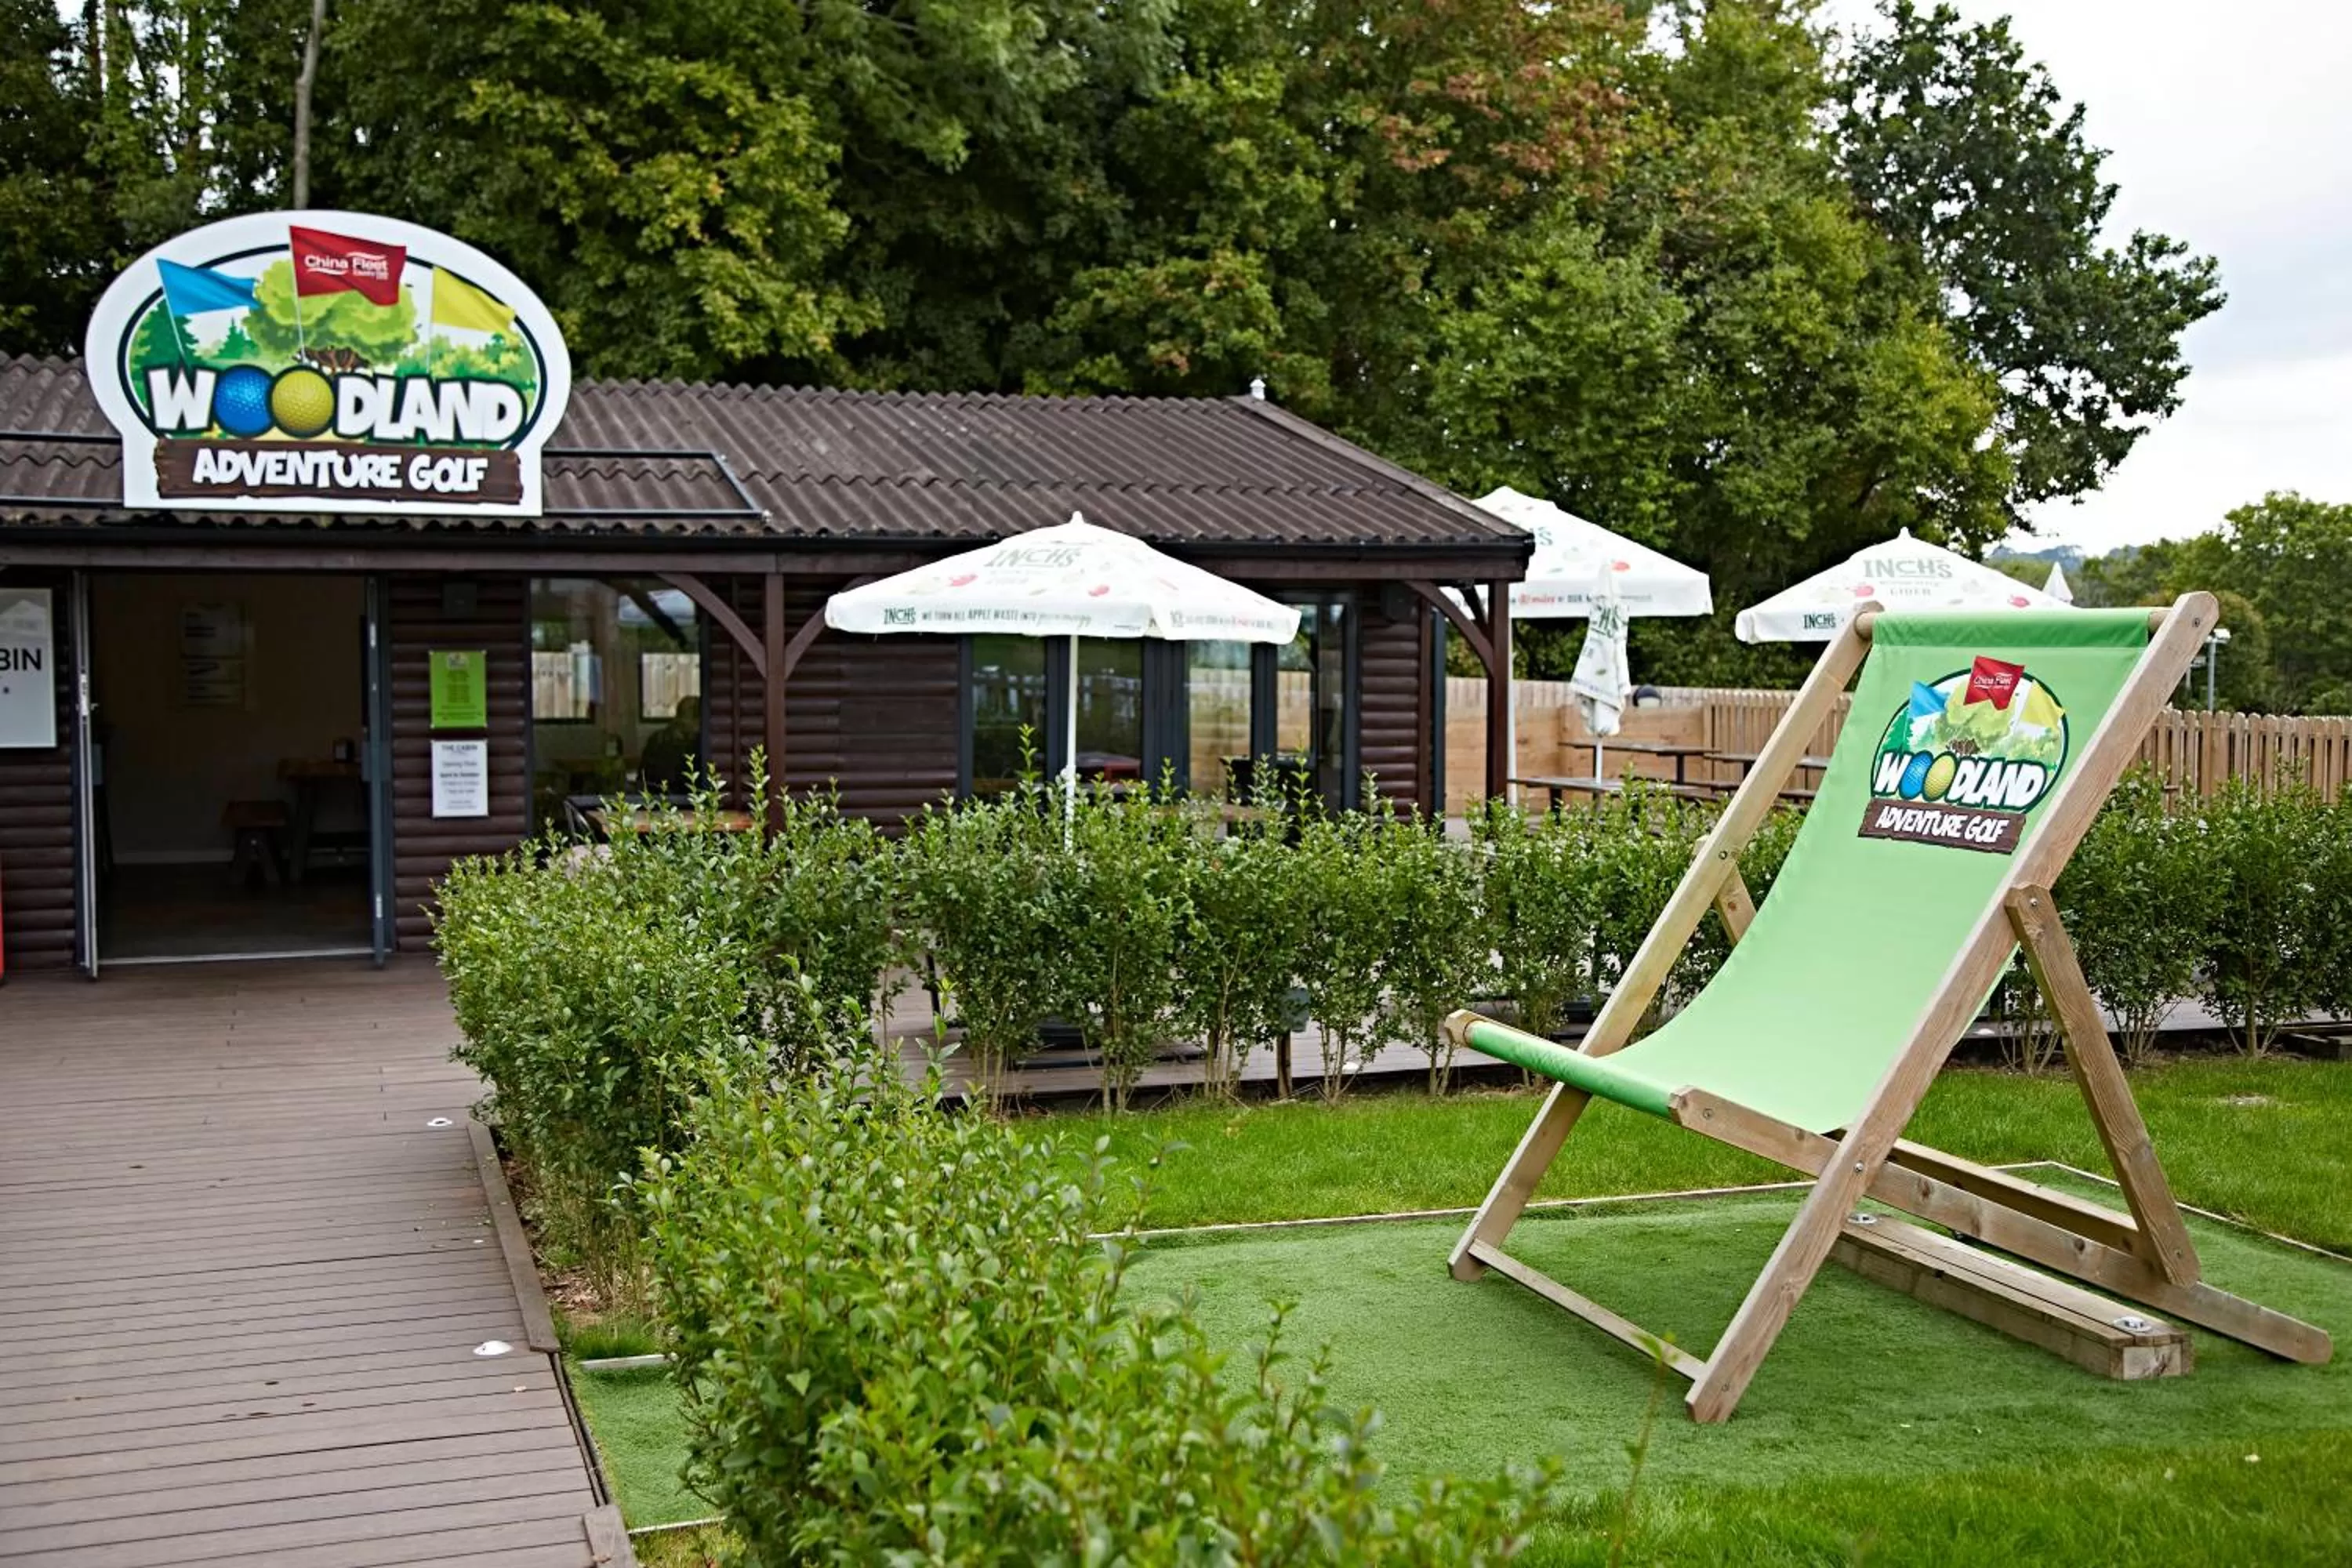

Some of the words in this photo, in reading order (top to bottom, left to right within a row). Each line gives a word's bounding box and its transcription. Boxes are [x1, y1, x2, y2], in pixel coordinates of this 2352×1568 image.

[304, 254, 349, 268] China
[147, 365, 523, 442] WOODLAND
[192, 448, 402, 488] ADVENTURE
[408, 454, 488, 493] GOLF
[1874, 750, 2045, 807] WOODLAND
[1875, 805, 1966, 838] ADVENTURE
[1964, 815, 2009, 843] GOLF
